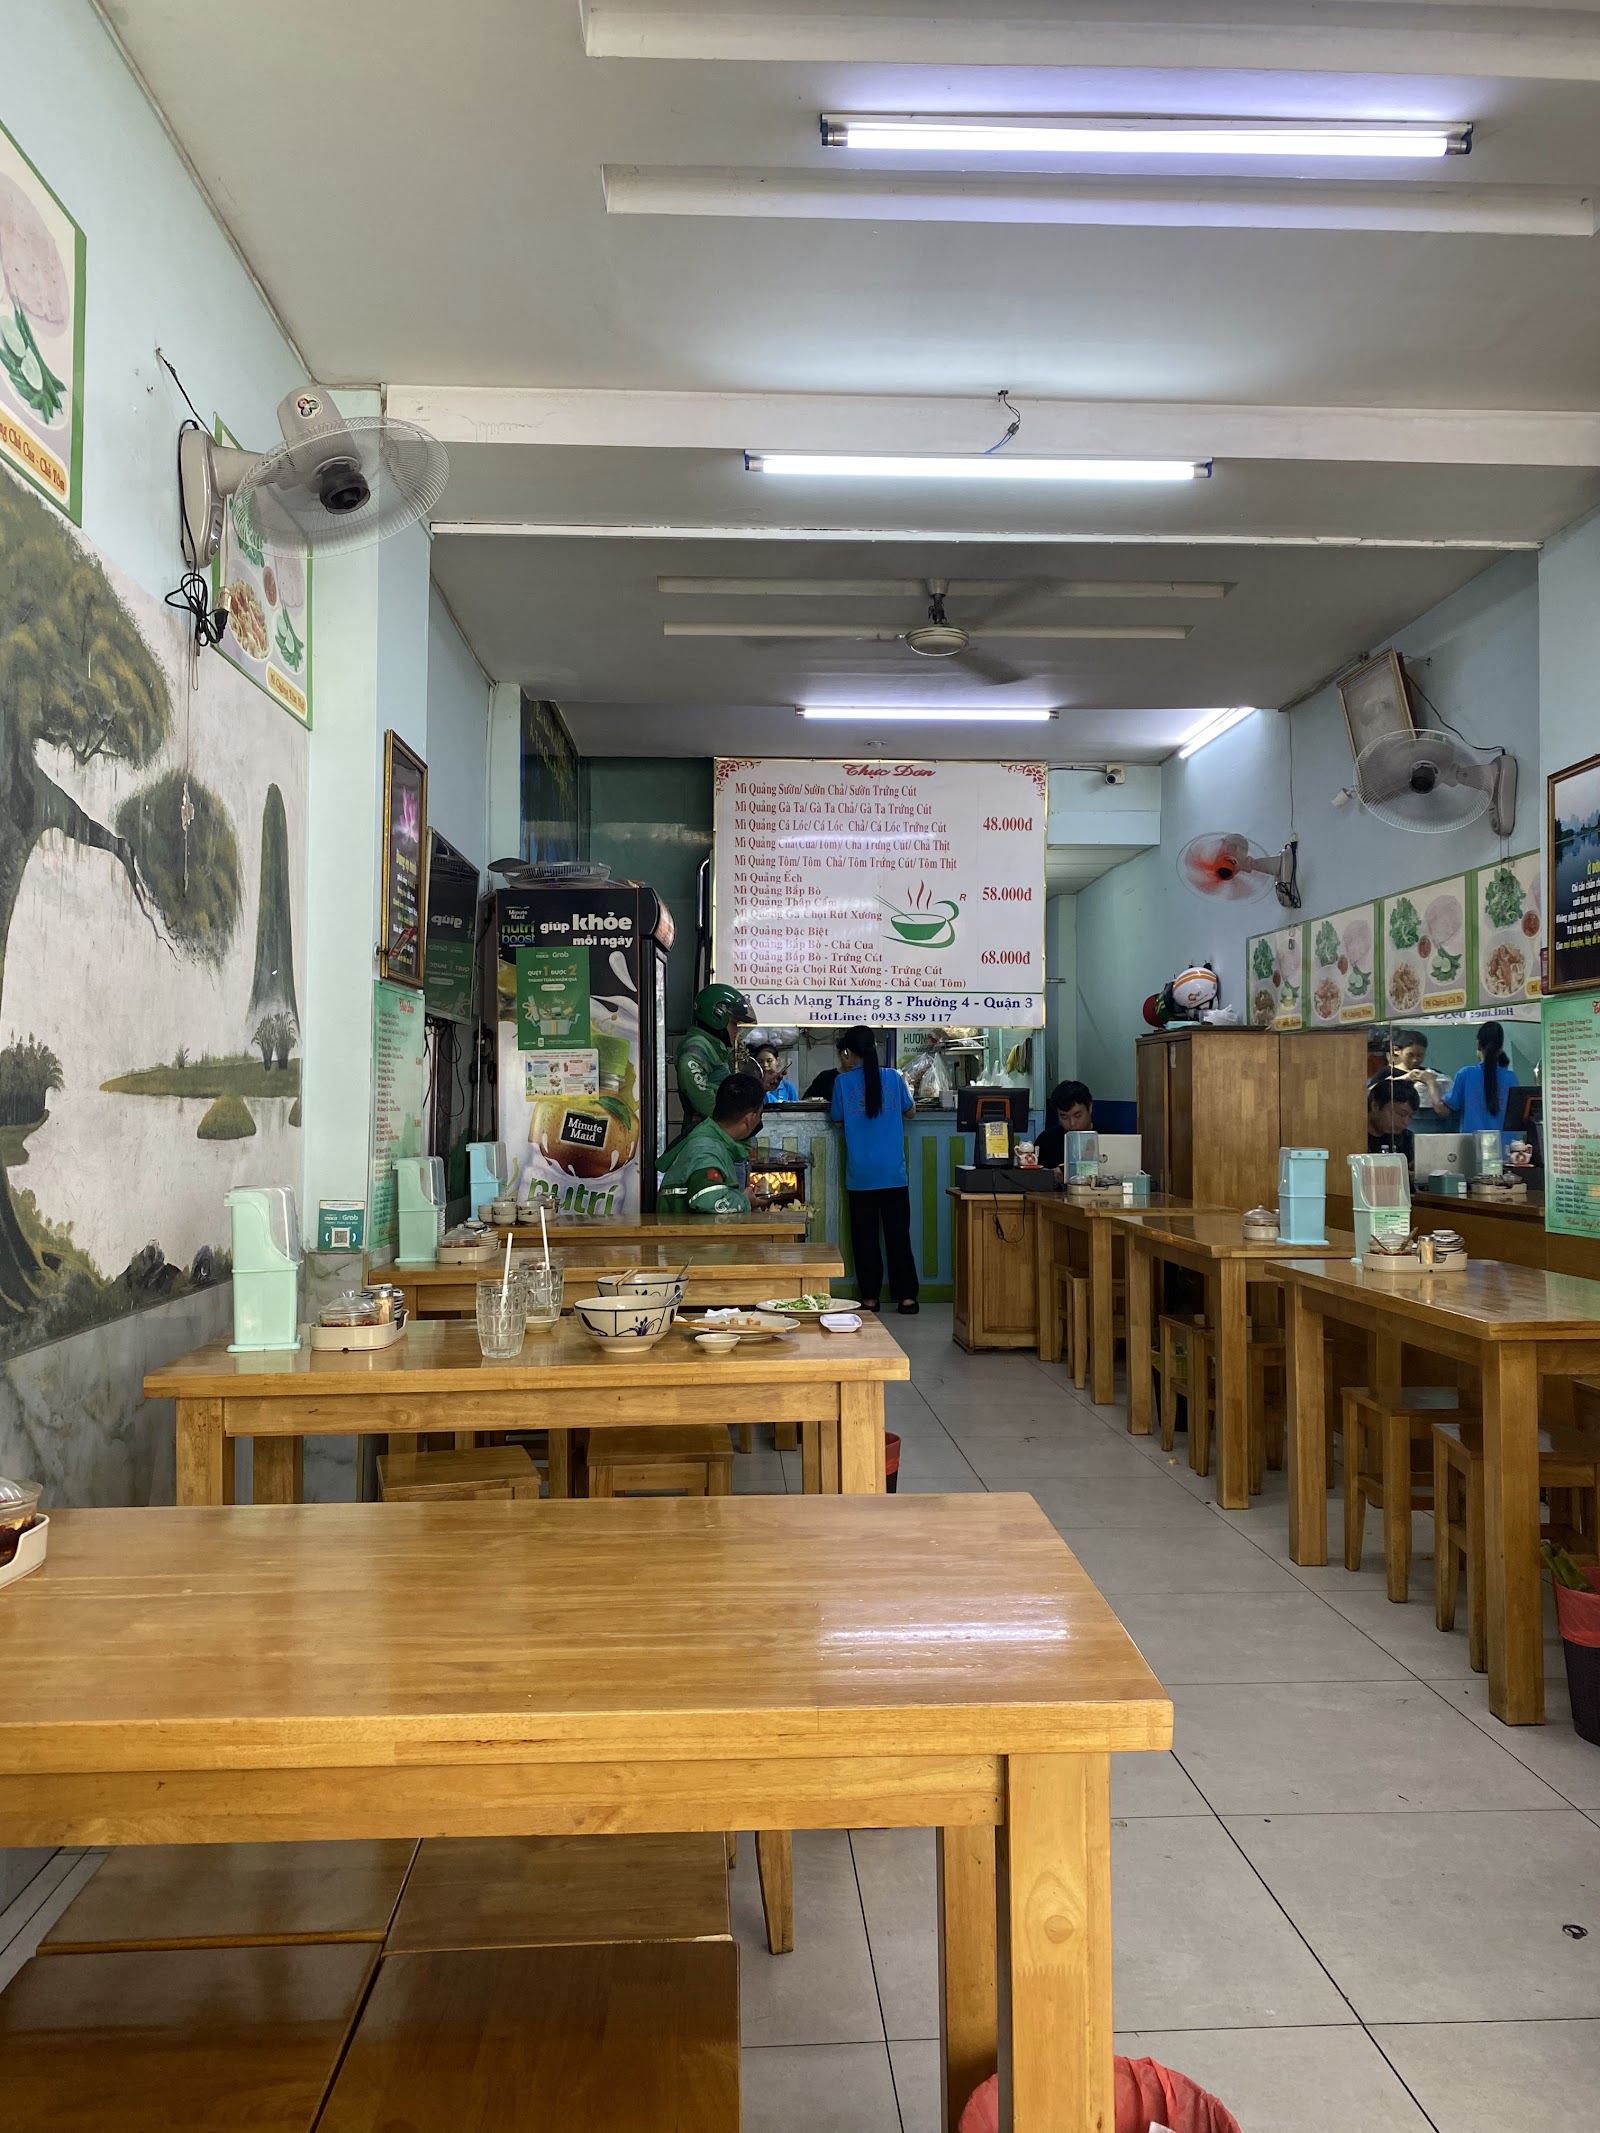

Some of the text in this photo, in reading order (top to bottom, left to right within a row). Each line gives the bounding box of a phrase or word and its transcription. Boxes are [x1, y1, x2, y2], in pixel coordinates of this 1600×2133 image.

[842, 764, 936, 778] Thực Đơn
[735, 782, 917, 798] Mì Quảng Sườn/ Sườn Chả/ Sườn Trứng Cút
[735, 800, 932, 817] Mì Quảng Gà Ta/ Gà Ta Chả/ Gà Ta Trứng Cút
[735, 818, 946, 834] Mì Quảng Cá Lóc/ Cá Lóc Chả/ Cá Lóc Trứng Cút
[983, 817, 1032, 831] 48.000đ
[735, 837, 746, 848] Mì
[749, 836, 776, 851] Quảng
[914, 839, 930, 851] Chả
[933, 840, 950, 853] Thịt
[735, 854, 957, 871] Mì Quảng Tôm/ Tôm Chả/ Tôm Trứng Cút/ Tôm Thịt
[735, 870, 802, 884] Mì Quảng Ếch
[734, 885, 821, 897] Mì Quảng Bắp Bò
[982, 887, 1032, 901] 58.000đ
[735, 897, 746, 906] Mì
[750, 896, 782, 908] Quảng
[829, 910, 847, 919] Rút
[851, 911, 882, 921] Xương
[540, 912, 633, 934] giúp khỏe
[735, 925, 828, 937] Mì Quảng Đặc Biệt
[502, 933, 536, 944] boost
[573, 934, 633, 948] mỗi ngày
[735, 938, 874, 951] Mì Quảng Bắp Bò Chả Cua
[735, 951, 882, 964] Mì Quảng Bắp Bò Trứng Cút
[981, 950, 1031, 965] 68.000đ
[734, 963, 943, 976] Mì Quảng Gà Chọi Rút Xương Trứng Cút
[734, 976, 746, 985] Mì
[750, 975, 782, 987] Quảng
[785, 976, 800, 986] Gà
[803, 977, 826, 987] Chọi
[829, 977, 847, 986] Rút
[850, 978, 882, 988] Xương
[891, 977, 910, 987] Chả
[756, 994, 789, 1005] Cách
[793, 995, 833, 1009] Mạng
[837, 995, 880, 1009] Tháng
[885, 996, 893, 1006] 8
[907, 996, 957, 1010] Phường
[961, 997, 970, 1007] 4
[984, 997, 1020, 1010] Quận
[1025, 998, 1033, 1008] 3
[809, 1012, 951, 1022] HotLine: 0933 589 117
[568, 1118, 603, 1143] Minute Maid
[342, 1213, 359, 1221] Grab
